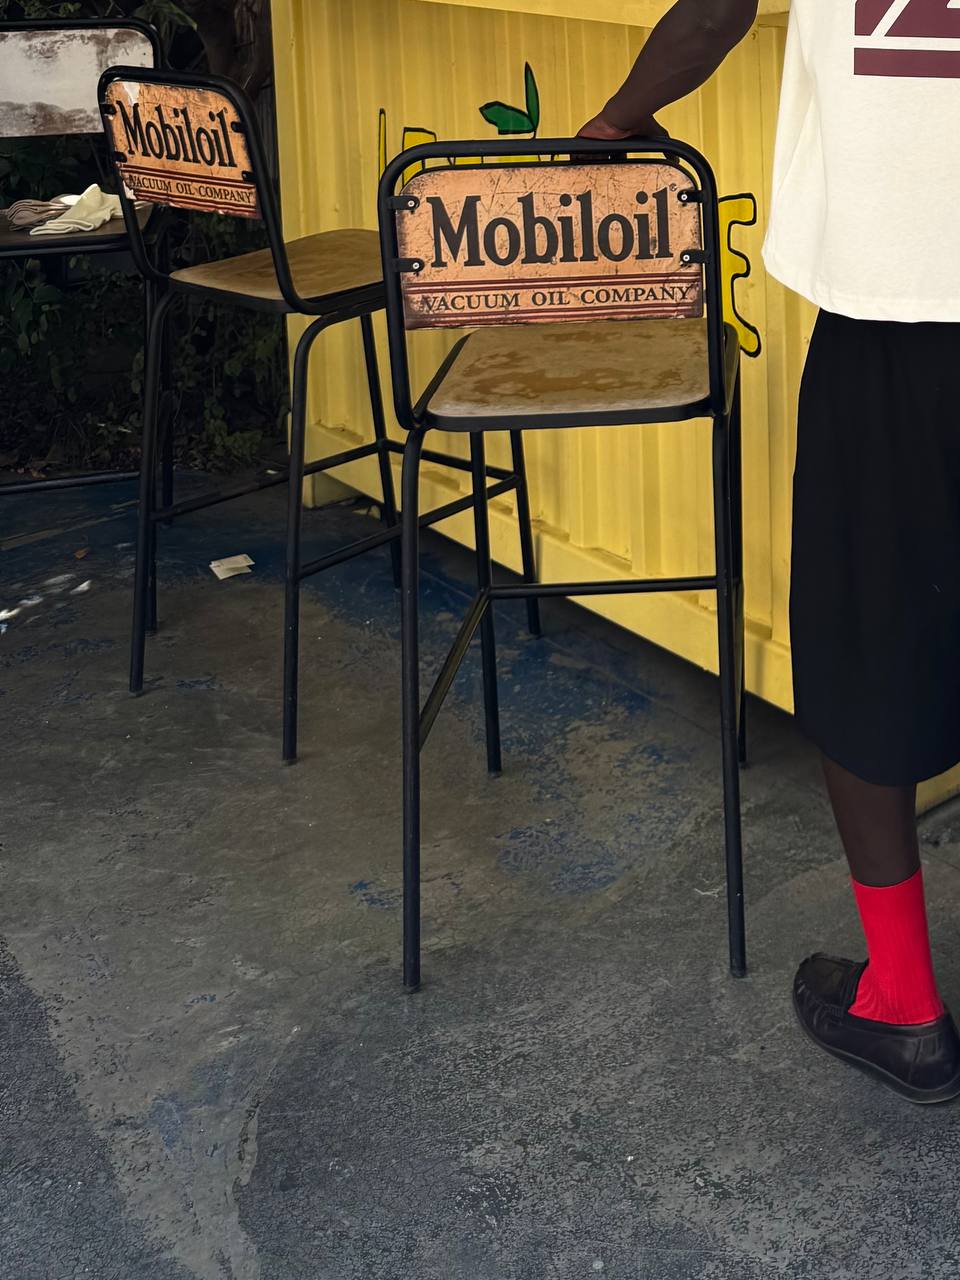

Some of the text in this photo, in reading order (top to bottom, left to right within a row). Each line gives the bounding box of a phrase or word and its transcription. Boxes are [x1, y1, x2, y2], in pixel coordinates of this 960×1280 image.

[116, 99, 237, 168] Mobiloil
[128, 174, 251, 204] VACUUM OIL COMPANY
[426, 185, 674, 268] Mobiloil
[422, 285, 692, 312] VACUUM OIL COMPANY
